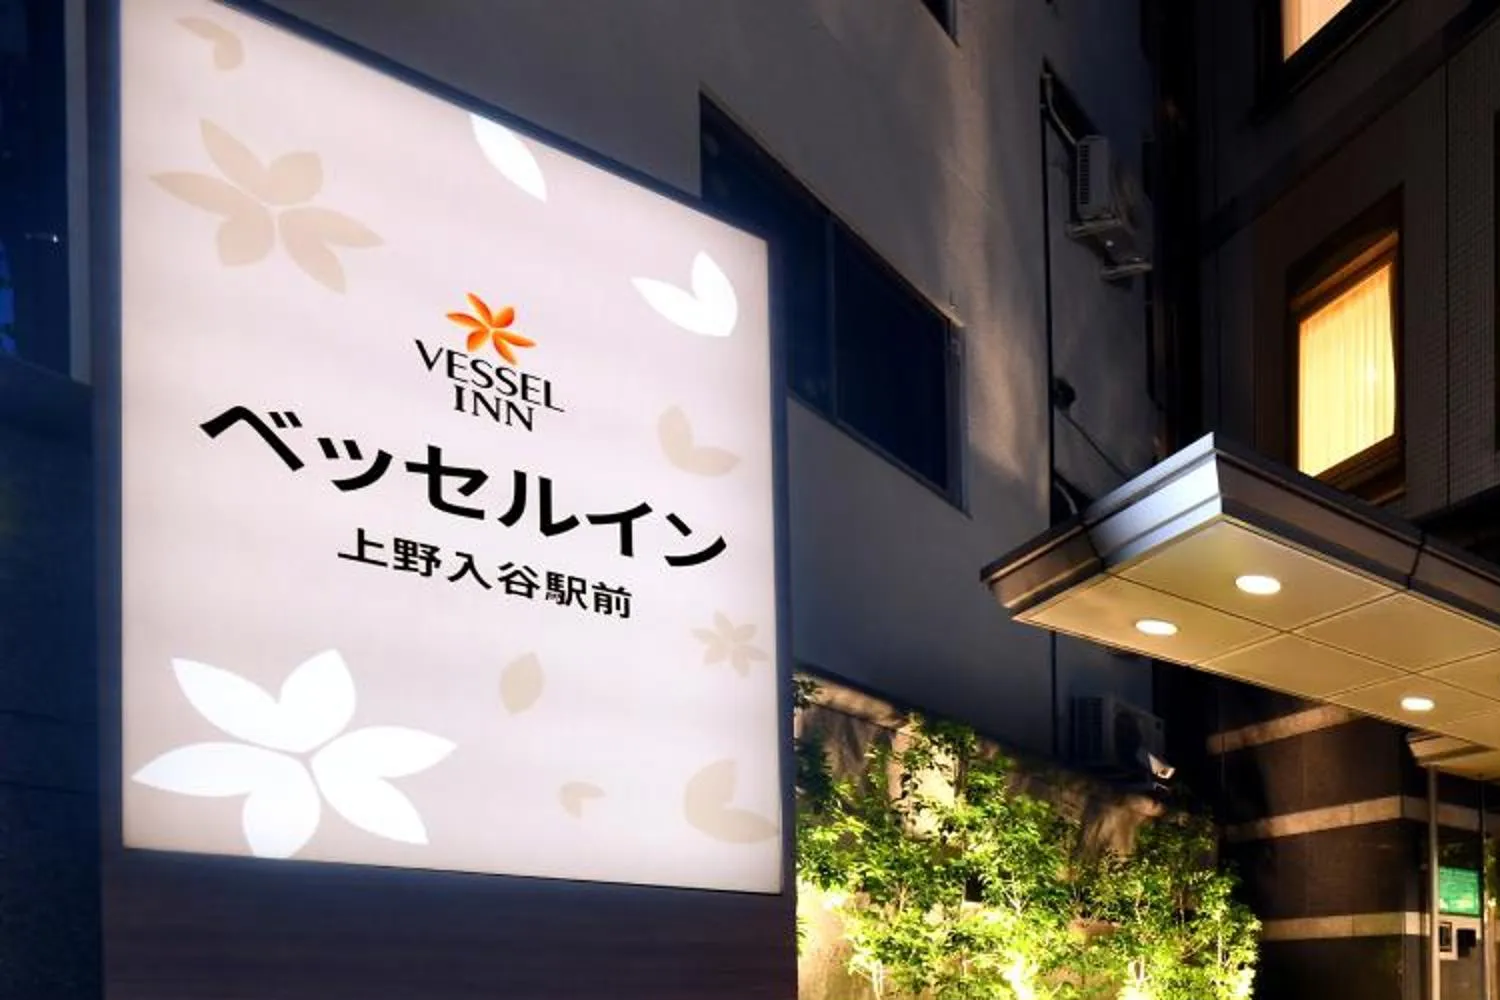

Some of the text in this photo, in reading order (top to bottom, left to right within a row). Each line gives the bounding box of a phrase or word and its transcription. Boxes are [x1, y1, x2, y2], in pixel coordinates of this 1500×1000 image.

[415, 339, 564, 413] VESSEL
[454, 386, 534, 432] INN
[199, 405, 727, 567] ベッセルイン
[337, 527, 632, 619] 上野入谷駅前
